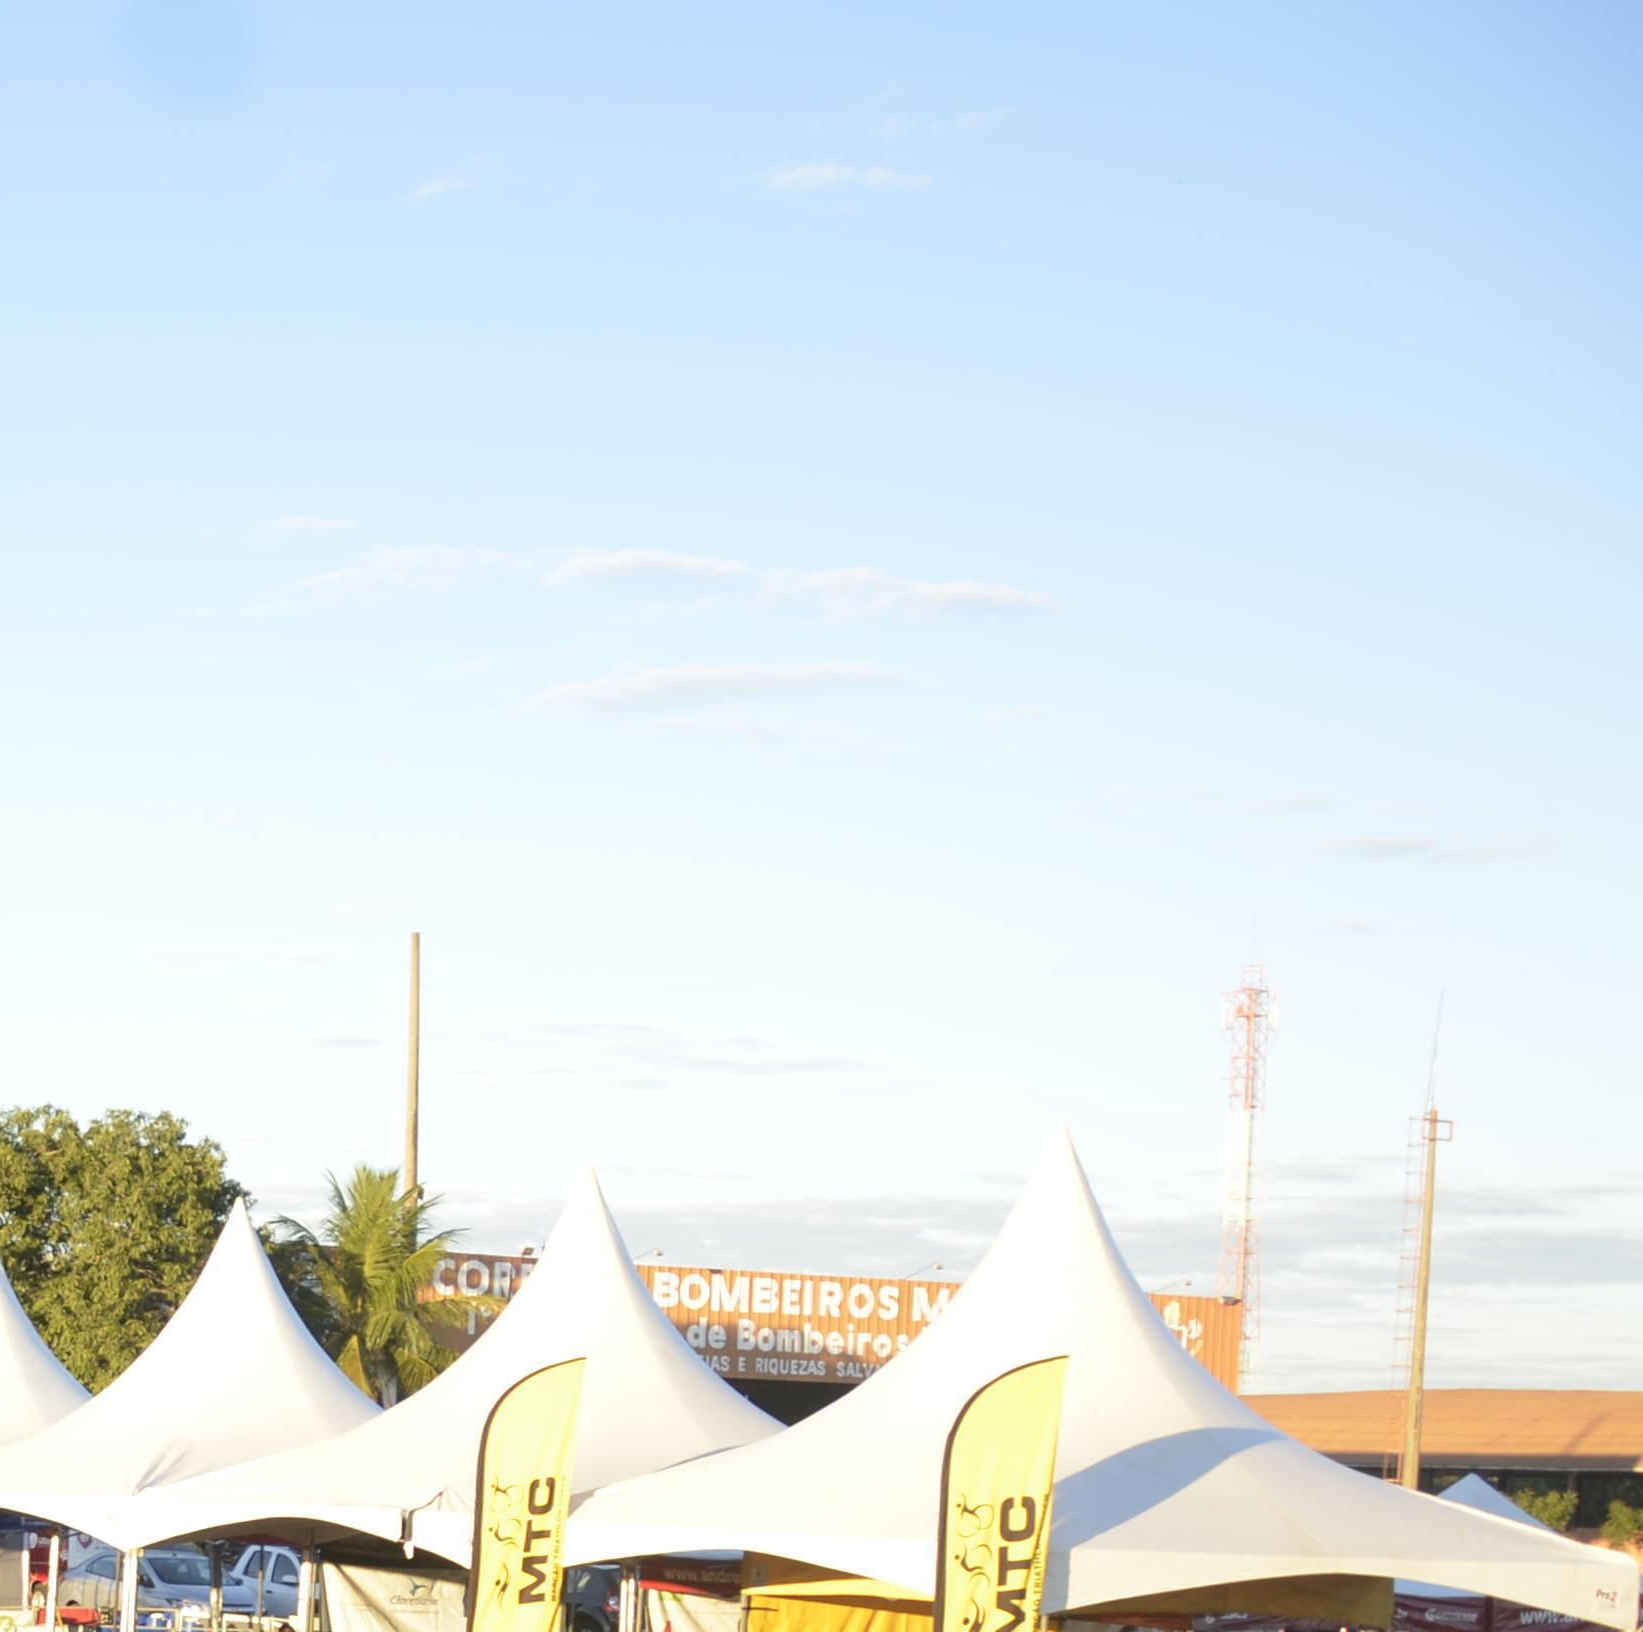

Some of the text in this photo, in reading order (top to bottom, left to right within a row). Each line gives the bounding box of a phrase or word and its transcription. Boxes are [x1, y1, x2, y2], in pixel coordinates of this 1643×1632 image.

[653, 1271, 900, 1319] BOMBEIROS
[686, 1317, 909, 1357] de Bombeiros
[755, 1357, 826, 1376] RIQUEZAS
[518, 1476, 556, 1604] MTC
